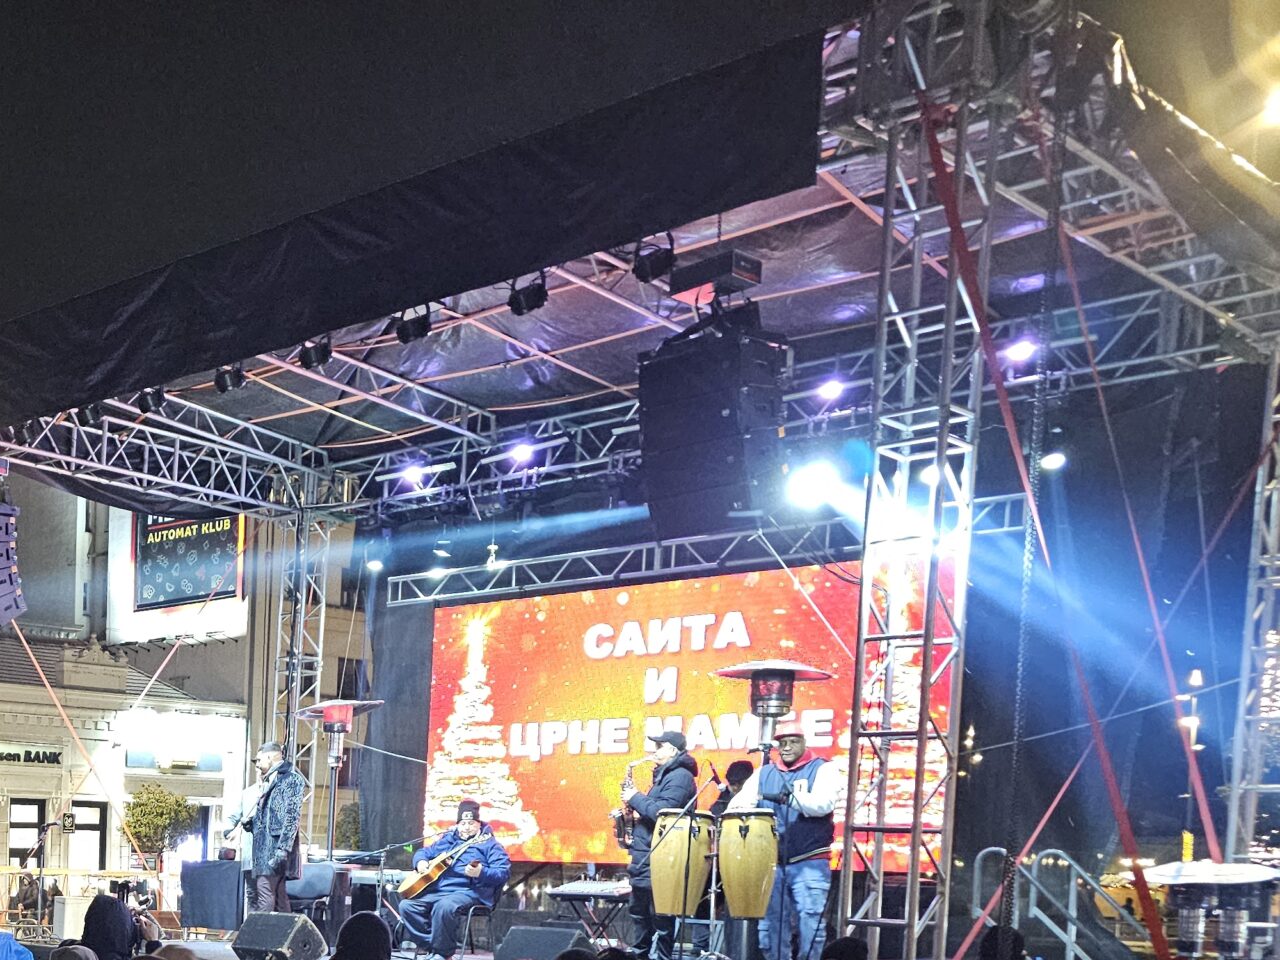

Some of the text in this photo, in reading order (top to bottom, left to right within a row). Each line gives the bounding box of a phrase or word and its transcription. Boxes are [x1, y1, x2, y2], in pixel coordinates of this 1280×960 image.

[146, 525, 199, 544] AUTOMAT
[201, 518, 231, 535] KLUB
[582, 611, 751, 660] САИТА
[644, 667, 679, 704] И
[508, 708, 835, 762] ЦРНЕ МАМЕ
[23, 750, 63, 764] BANK
